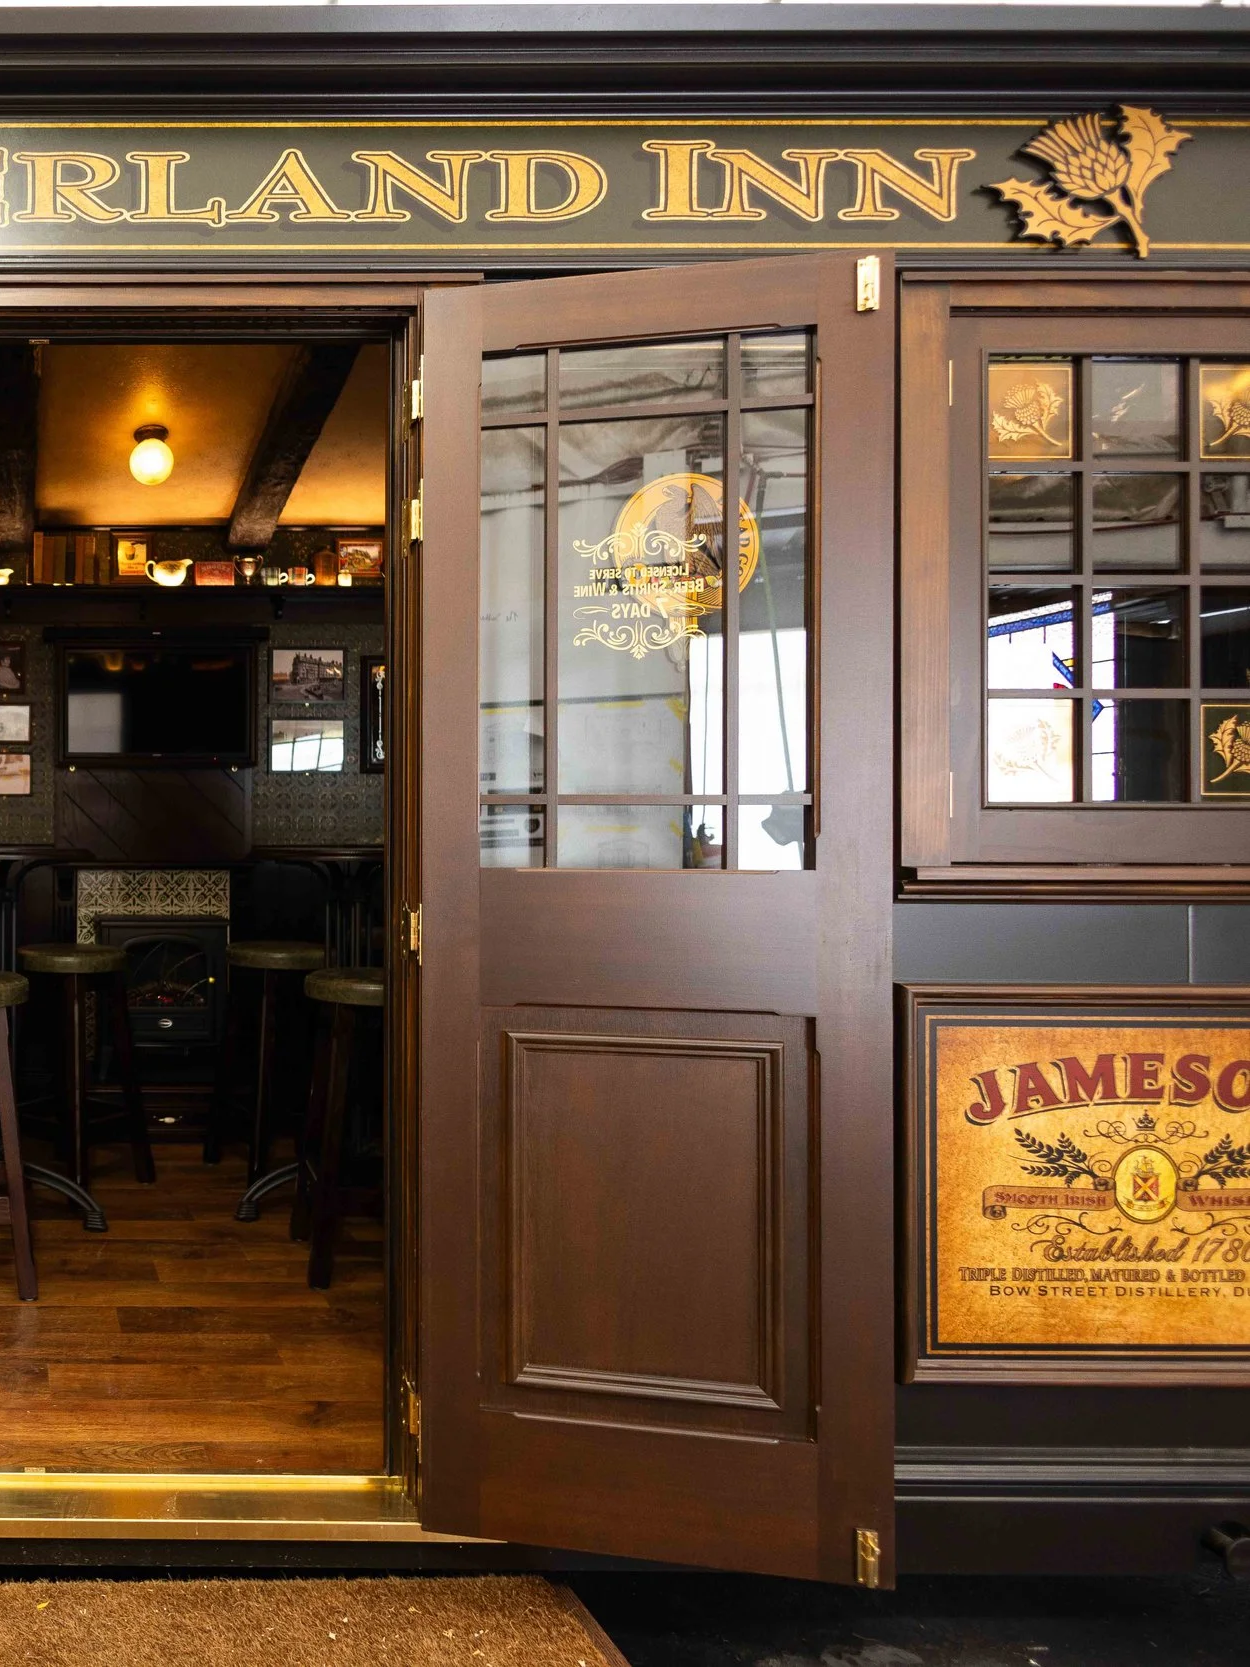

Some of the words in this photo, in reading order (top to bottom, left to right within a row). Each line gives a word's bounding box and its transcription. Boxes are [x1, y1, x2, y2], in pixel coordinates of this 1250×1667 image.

[642, 138, 977, 222] INN
[993, 1191, 1059, 1206] SMOOTH
[1062, 1193, 1107, 1206] IRISH
[1030, 1234, 1191, 1264] Established
[959, 1266, 1007, 1282] TRIPLE
[1090, 1267, 1161, 1283] MATURED
[1165, 1269, 1176, 1283] &
[1180, 1268, 1246, 1283] BOTTLED
[989, 1285, 1038, 1296] BOW
[1038, 1285, 1109, 1296] STREET
